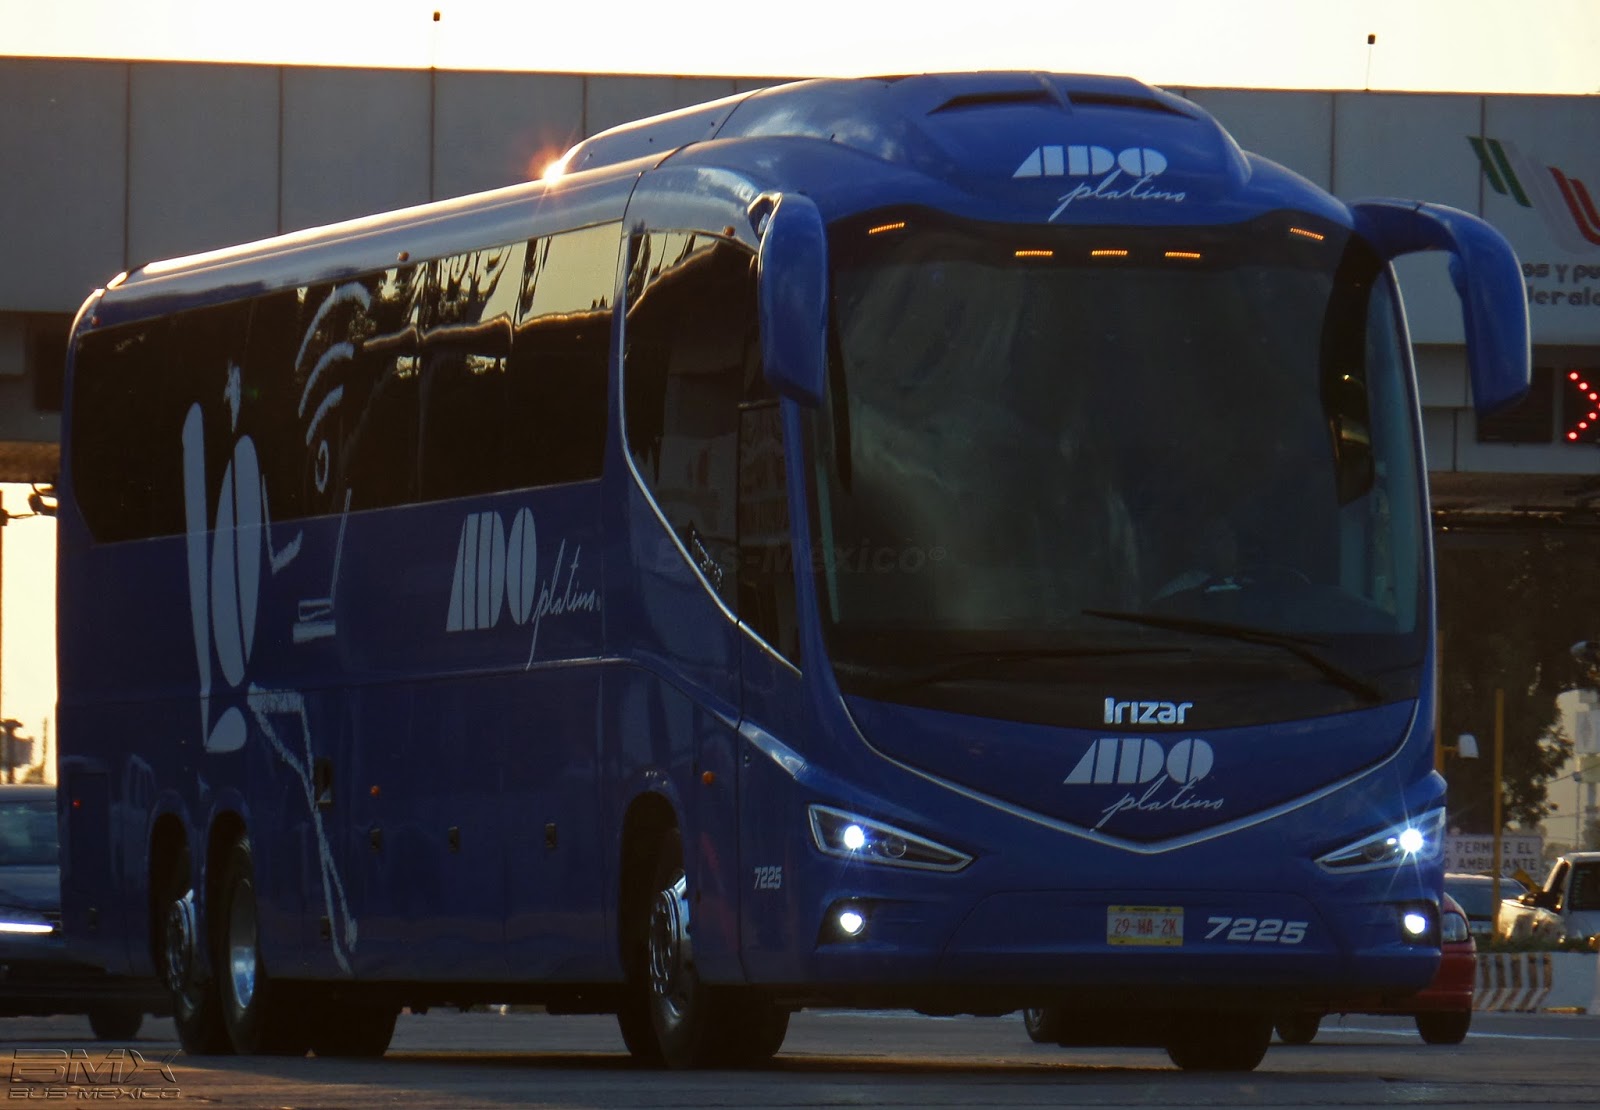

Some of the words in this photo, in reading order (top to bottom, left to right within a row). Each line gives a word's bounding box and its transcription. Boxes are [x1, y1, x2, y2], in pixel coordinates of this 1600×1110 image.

[1012, 145, 1168, 178] ADO
[1048, 168, 1186, 222] platino
[1522, 263, 1550, 278] os
[1573, 264, 1600, 284] pu
[446, 506, 537, 632] ADO
[525, 538, 601, 671] platino
[1104, 697, 1194, 725] Irizar
[1063, 738, 1214, 784] ADO
[1089, 773, 1225, 833] platino
[1455, 841, 1511, 854] PERME
[1517, 841, 1533, 855] EL
[754, 866, 783, 890] 7225
[1458, 858, 1537, 871] AMBUANTE
[1204, 917, 1309, 944] 7225
